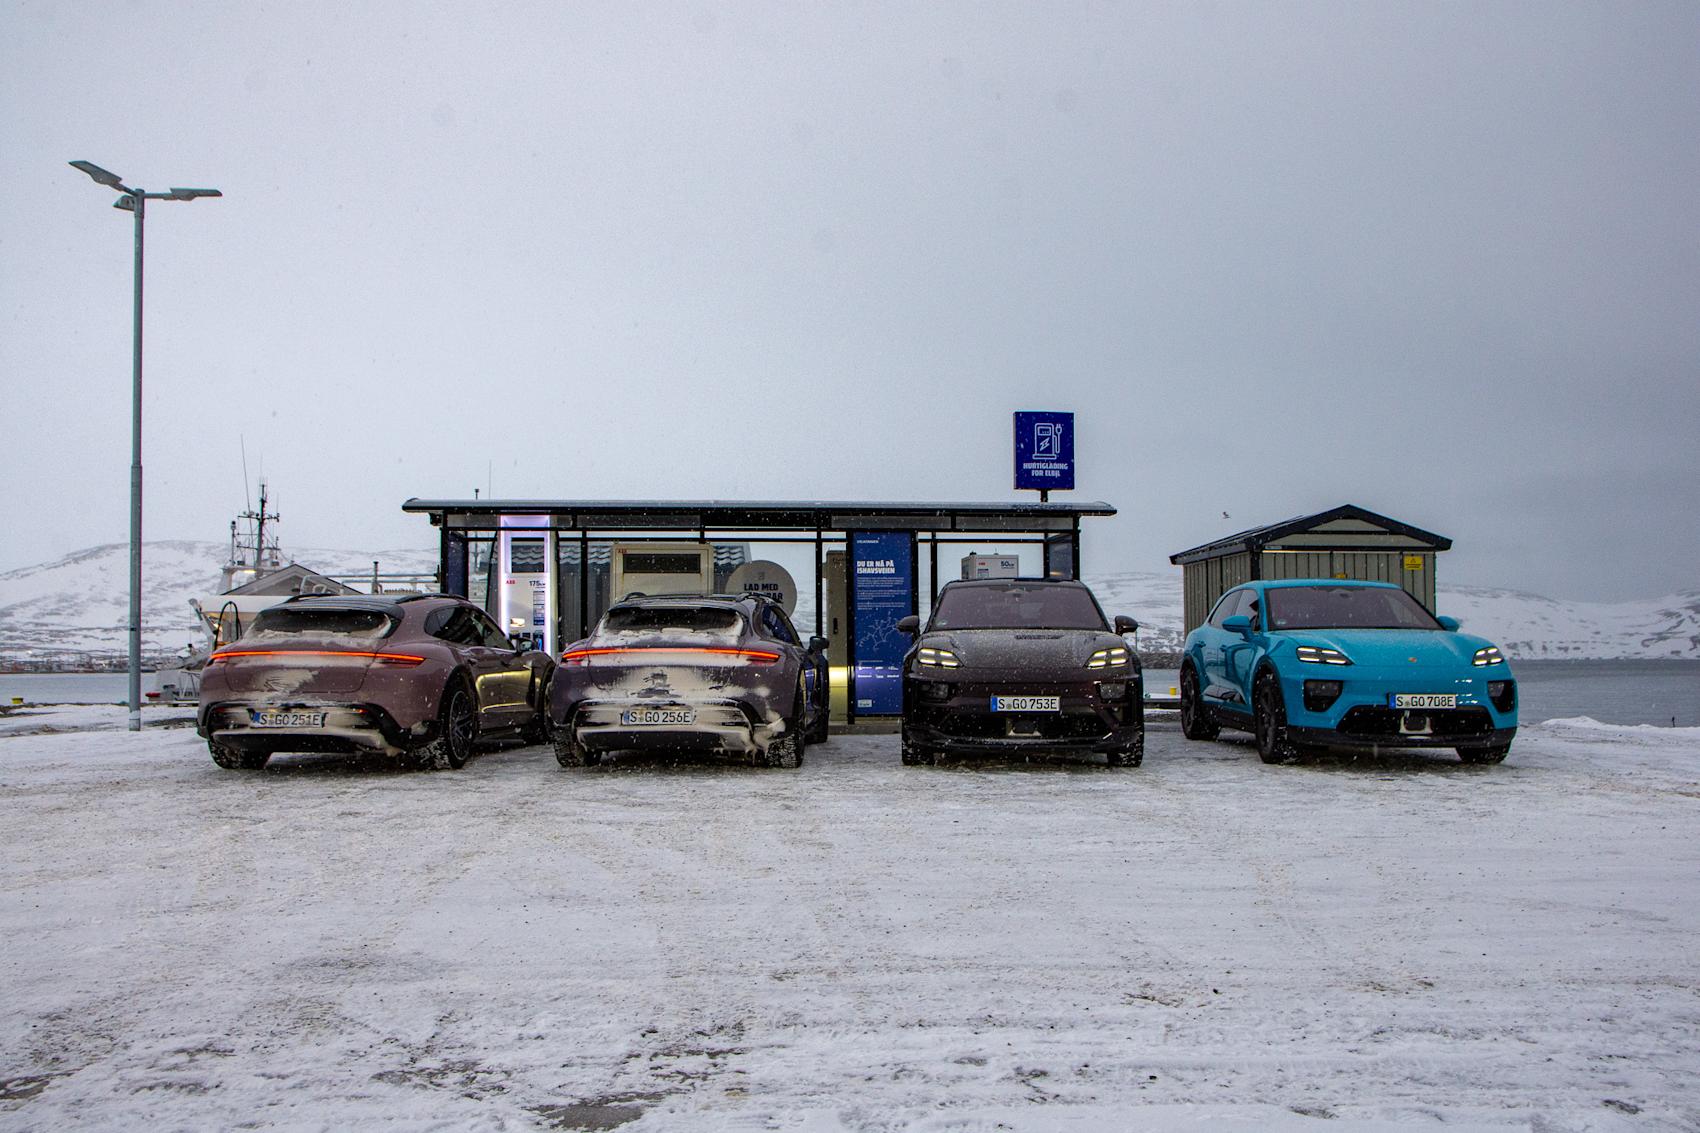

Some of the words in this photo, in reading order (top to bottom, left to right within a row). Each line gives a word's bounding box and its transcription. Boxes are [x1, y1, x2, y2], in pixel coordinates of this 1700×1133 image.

[998, 698, 1005, 710] S
[1012, 698, 1027, 710] GO
[1030, 698, 1057, 710] 753E
[1396, 696, 1404, 706] S
[1410, 696, 1425, 706] GO
[1427, 696, 1454, 706] 708E
[260, 714, 268, 725] S
[291, 714, 320, 726] 251E
[630, 712, 637, 722] S
[645, 712, 660, 722] GO
[662, 712, 690, 722] 256E
